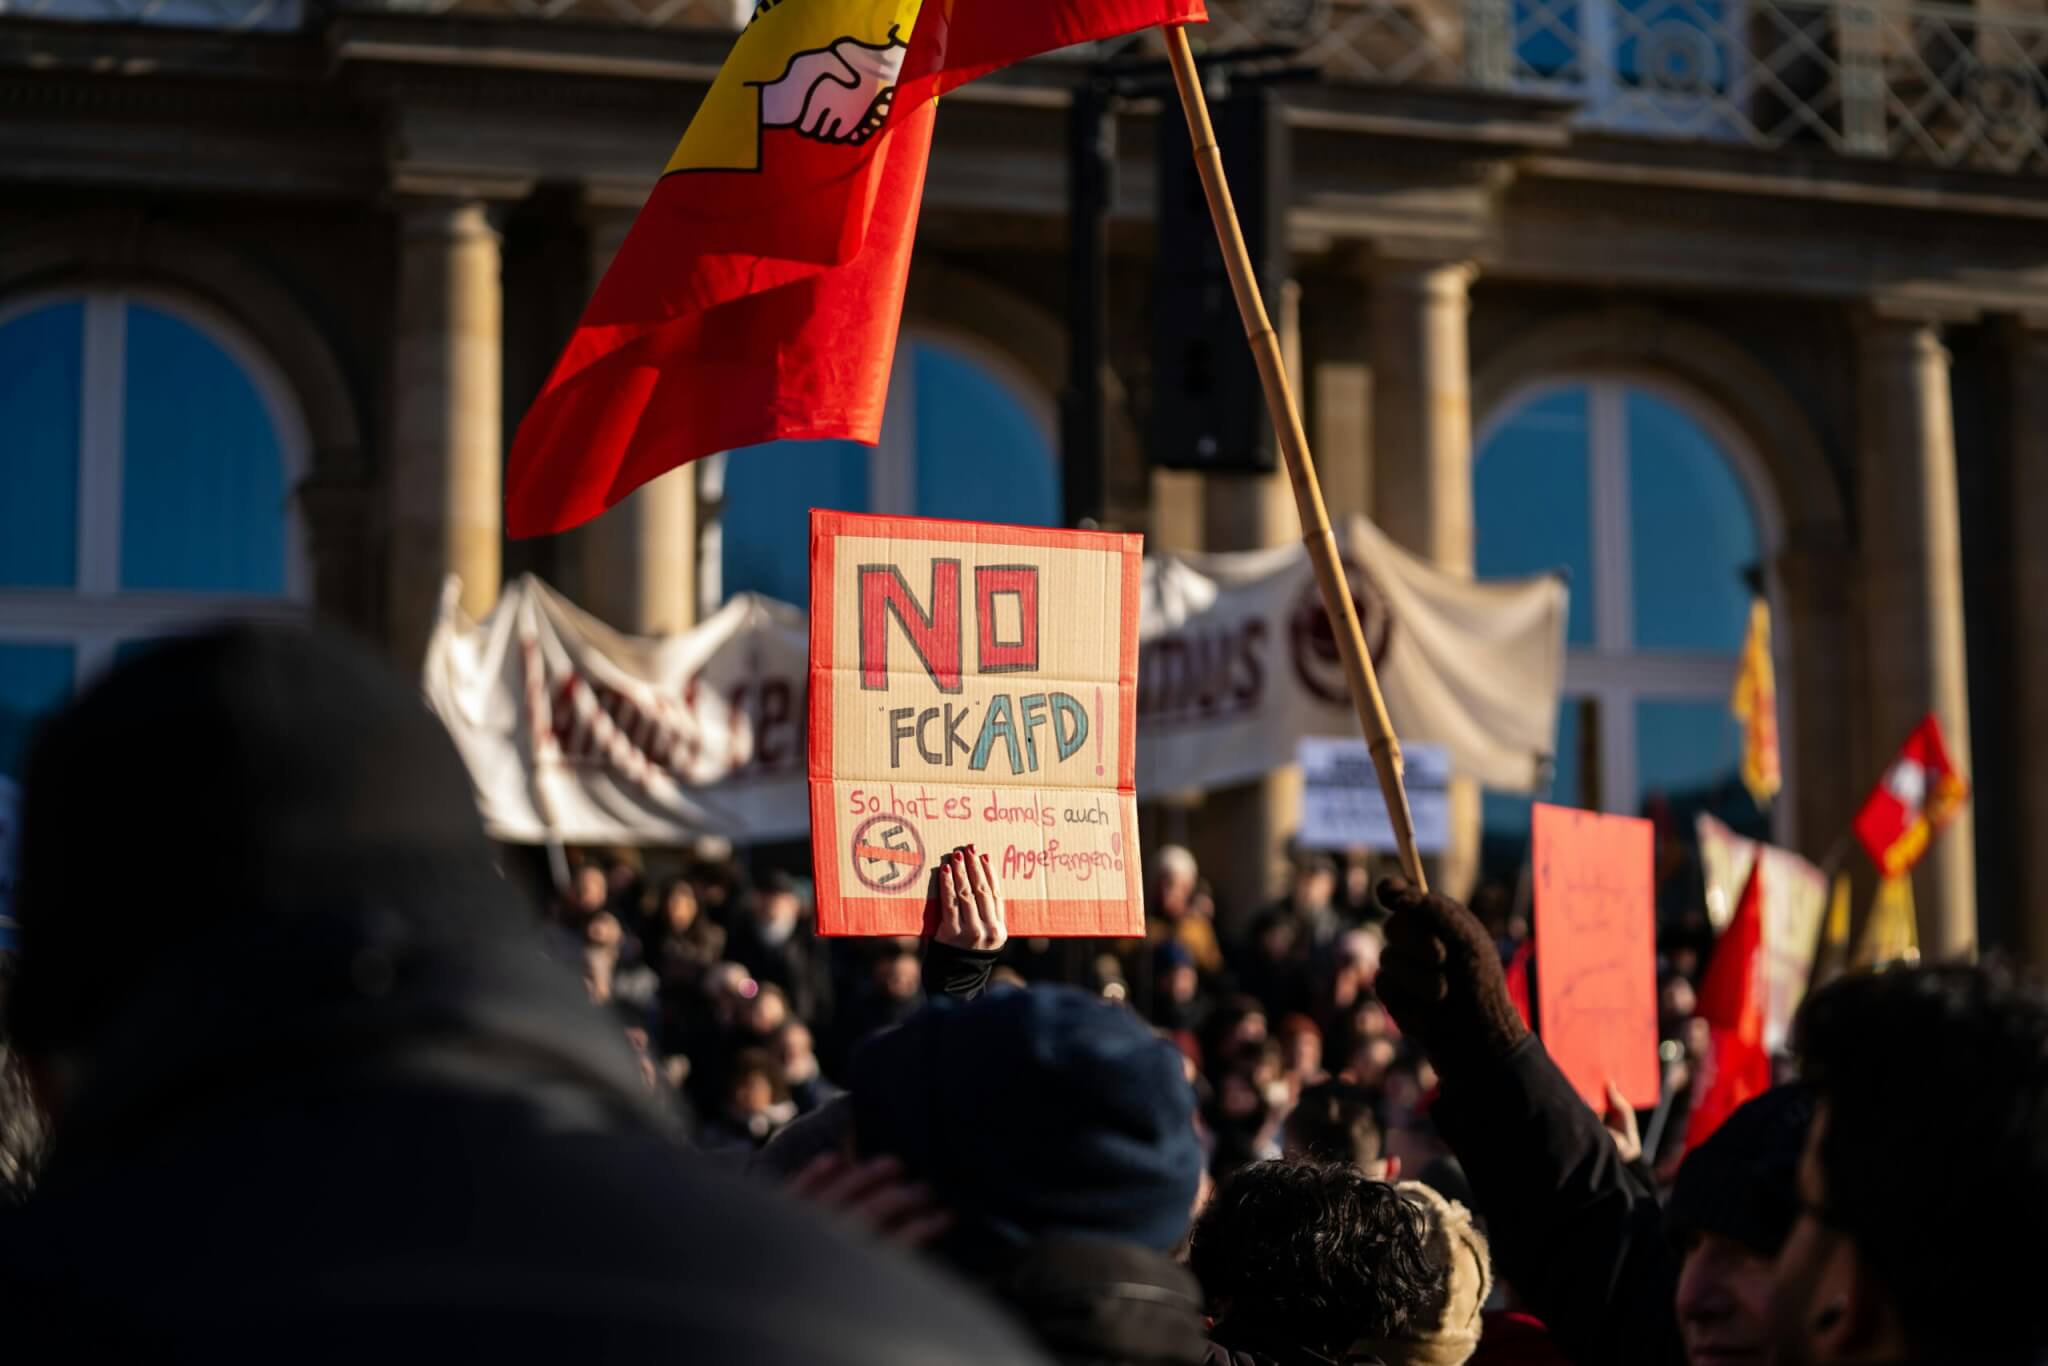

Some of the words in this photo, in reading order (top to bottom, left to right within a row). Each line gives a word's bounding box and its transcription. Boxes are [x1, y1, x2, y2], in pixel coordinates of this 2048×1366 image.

[857, 558, 1039, 694] NO
[850, 789, 880, 815] So
[889, 784, 939, 820] hat
[944, 795, 972, 820] es
[983, 790, 1056, 827] damals
[1063, 797, 1109, 825] auch
[1002, 832, 1123, 880] Angefangen!
